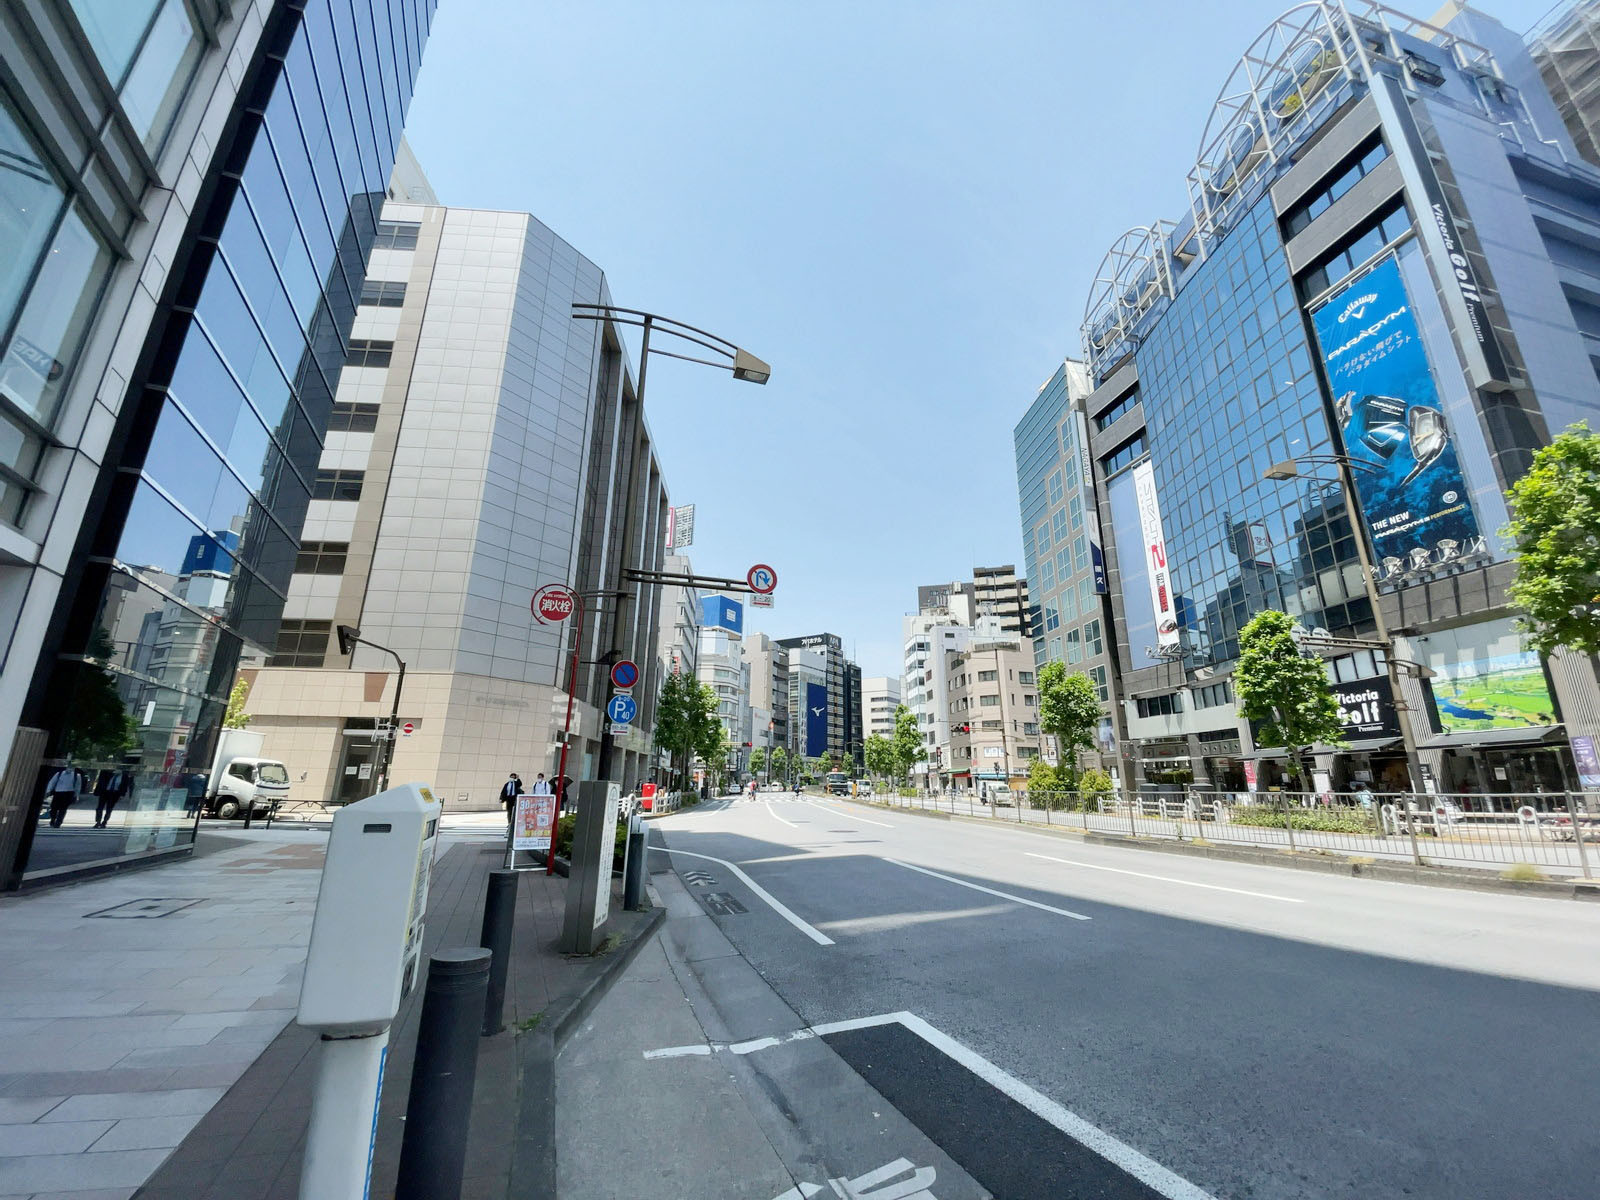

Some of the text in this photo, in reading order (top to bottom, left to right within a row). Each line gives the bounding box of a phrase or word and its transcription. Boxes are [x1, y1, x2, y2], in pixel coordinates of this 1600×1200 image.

[1432, 203, 1485, 342] Victoria Golf Premium
[1338, 293, 1378, 323] Callaway
[1371, 511, 1409, 531] THE NEW
[541, 598, 571, 613] 消火栓
[614, 701, 626, 718] P
[1336, 701, 1380, 726] Golf
